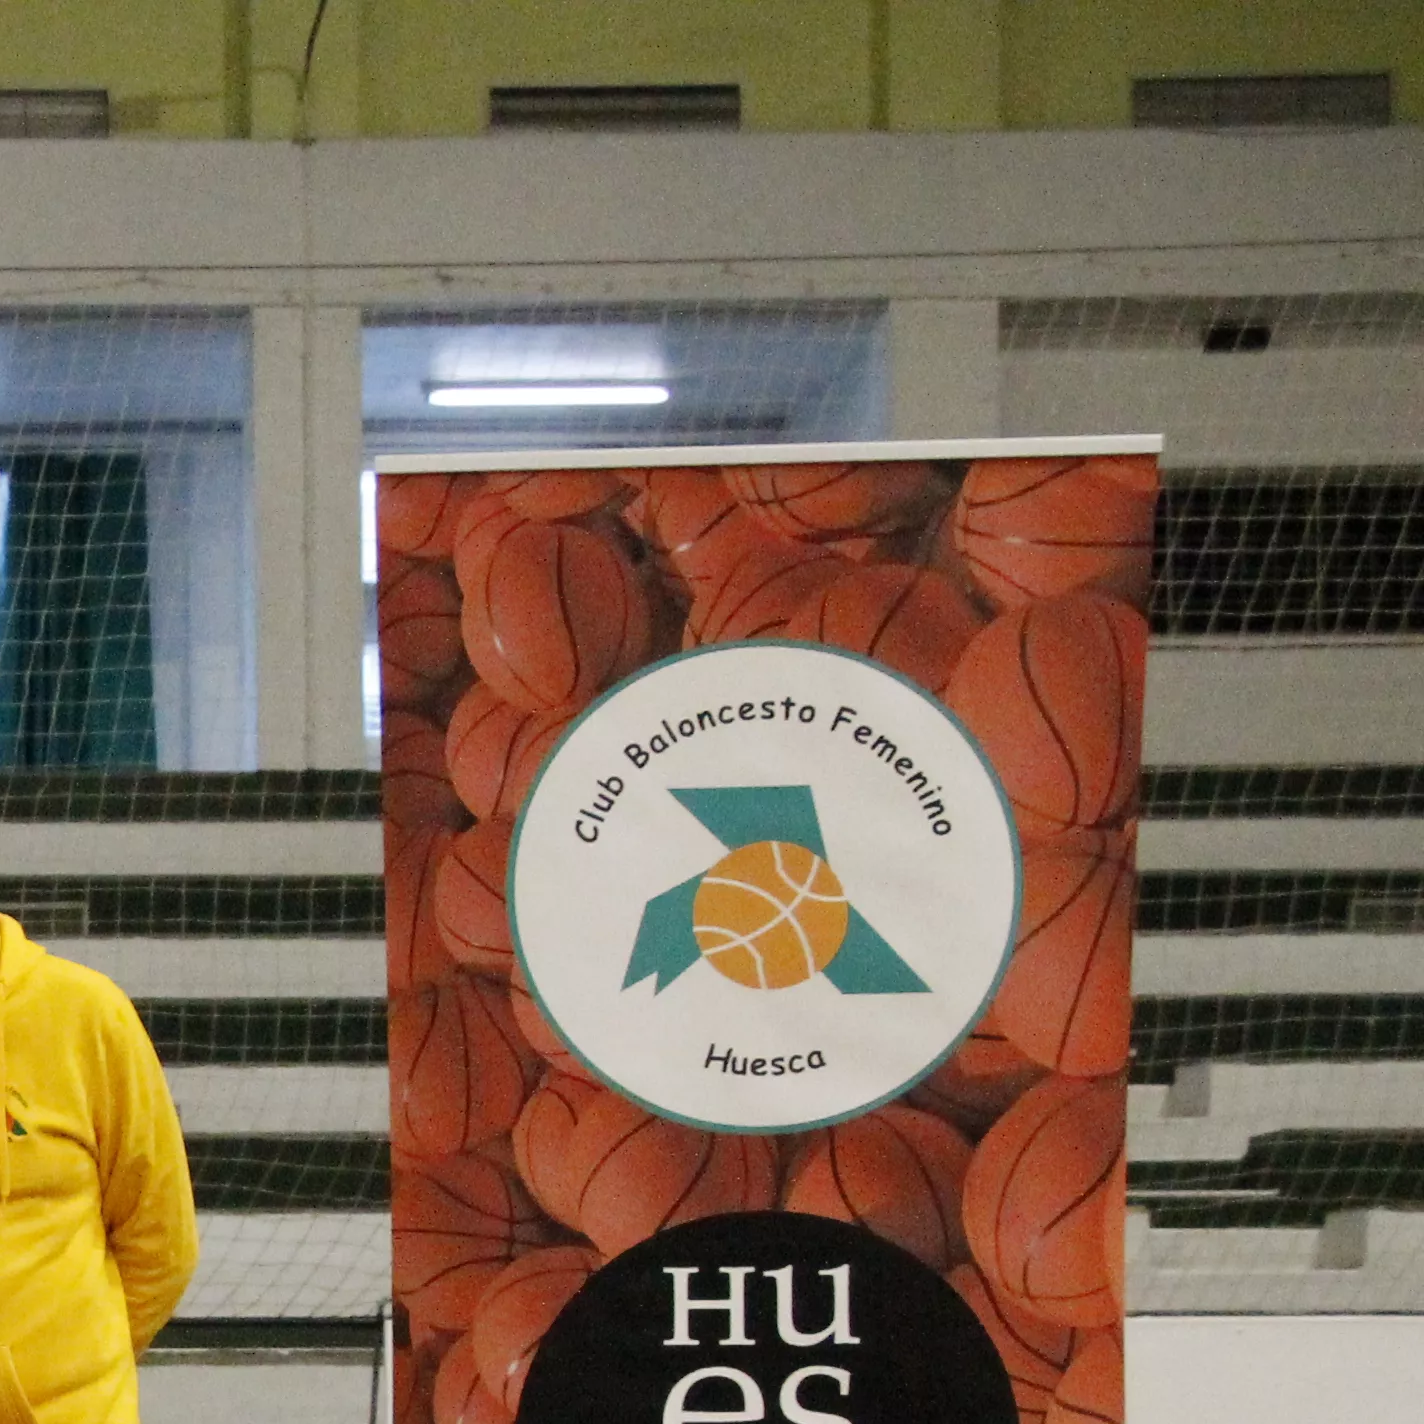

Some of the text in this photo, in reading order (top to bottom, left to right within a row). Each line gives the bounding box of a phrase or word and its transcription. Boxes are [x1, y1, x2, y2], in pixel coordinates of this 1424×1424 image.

[575, 695, 952, 845] Club Baloncesto Femenino
[704, 1043, 827, 1078] Huesca
[662, 1264, 862, 1348] Hu
